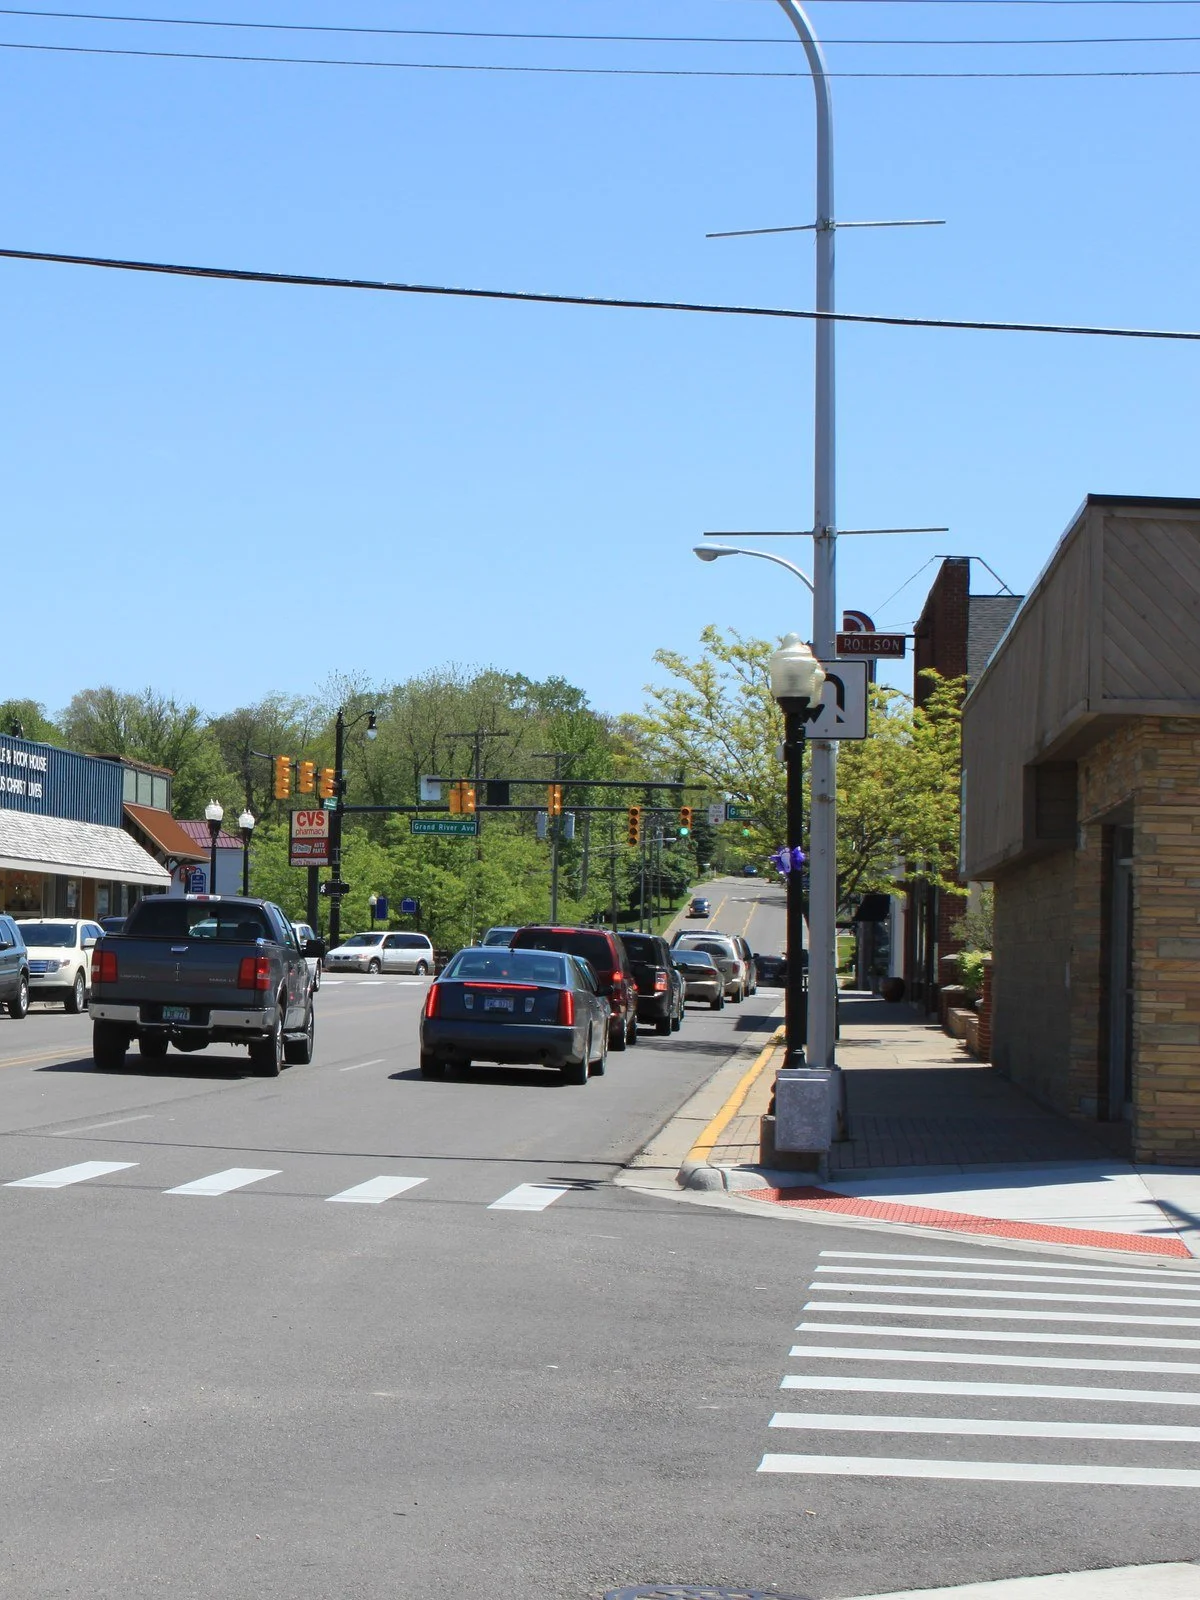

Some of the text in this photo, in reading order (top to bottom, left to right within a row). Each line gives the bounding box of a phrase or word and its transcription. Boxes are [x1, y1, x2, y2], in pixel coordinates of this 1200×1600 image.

[6, 750, 12, 764] &
[29, 754, 47, 772] HOUSE
[7, 777, 26, 796] CHRIST
[28, 782, 42, 798] LIVES
[296, 811, 325, 827] CVS
[295, 828, 325, 837] pharmacy
[414, 823, 435, 831] Grand
[438, 824, 457, 832] River
